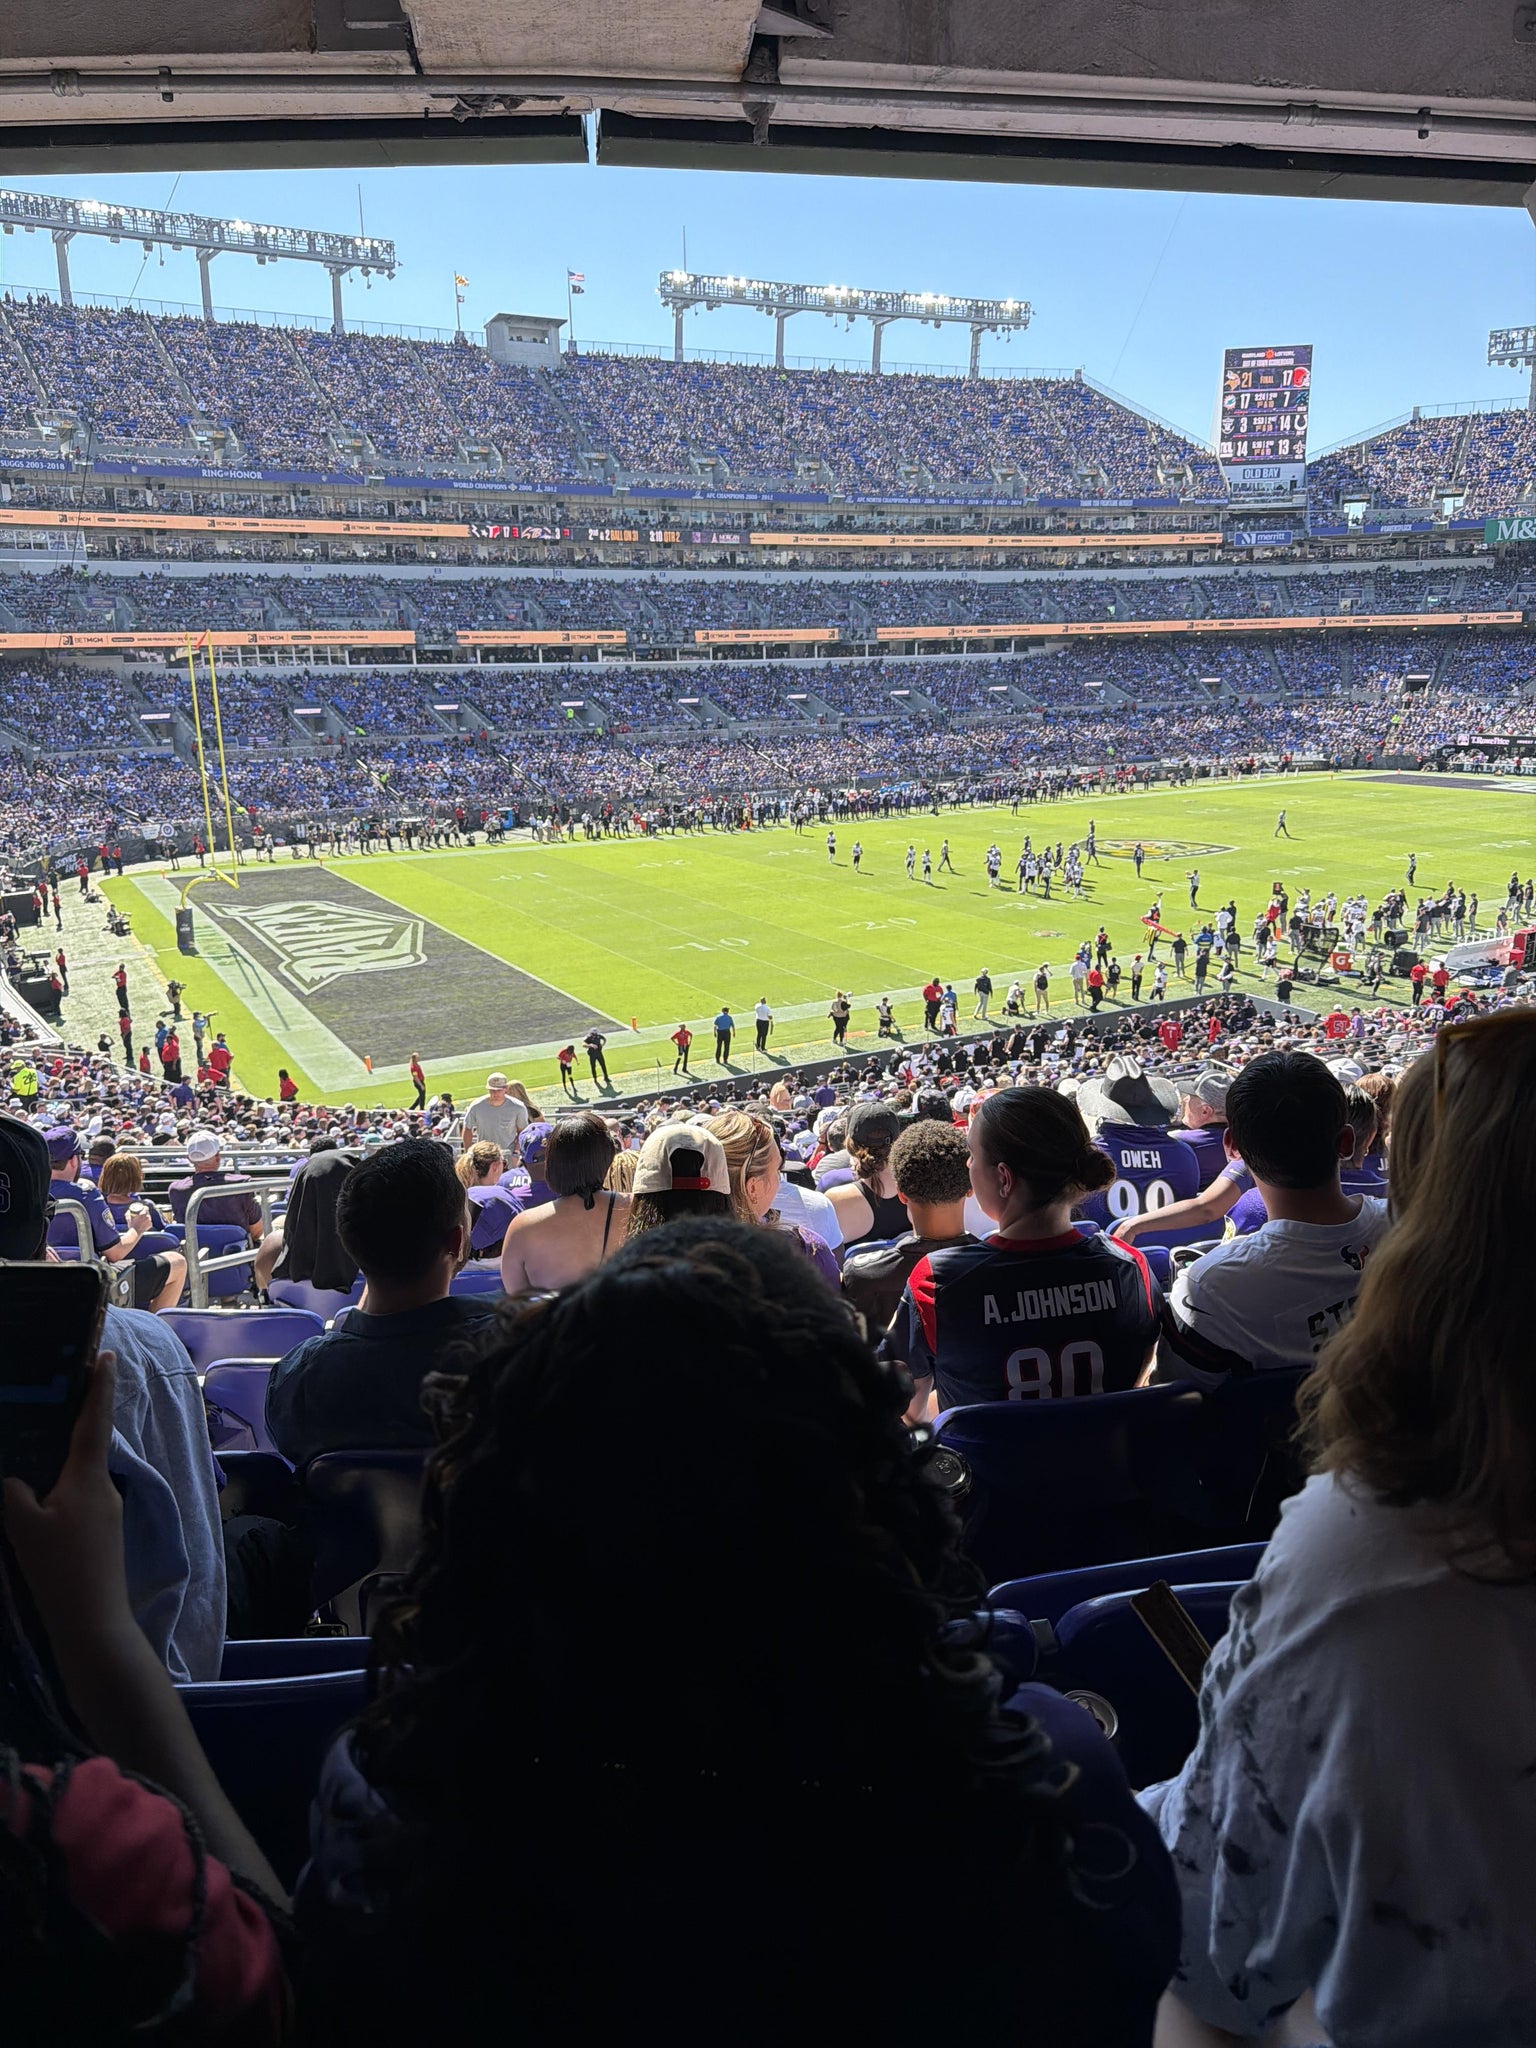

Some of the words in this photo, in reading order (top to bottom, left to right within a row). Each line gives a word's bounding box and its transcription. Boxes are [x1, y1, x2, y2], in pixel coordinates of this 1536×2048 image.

[1241, 372, 1252, 388] 21
[1260, 375, 1274, 384] FINAL
[1283, 370, 1293, 386] 17
[1240, 393, 1250, 409] 17
[1284, 391, 1290, 407] 7
[1240, 417, 1247, 433] 3
[1280, 415, 1290, 431] 14
[1237, 440, 1248, 456] 14
[1278, 439, 1290, 455] 13
[0, 460, 24, 468] SUGGS
[24, 461, 65, 470] 2003-2018
[202, 469, 224, 477] RING
[229, 470, 263, 480] HONOR
[1244, 469, 1262, 479] OLD
[1262, 468, 1280, 478] BAY
[474, 482, 507, 490] CHAMPIONS
[716, 491, 745, 499] CHAMPIONS
[610, 530, 623, 541] BALL
[1257, 533, 1285, 541] merritt
[1496, 518, 1536, 541] M&
[1462, 764, 1536, 775] BALTMOR
[217, 902, 416, 986] RAVENS
[1336, 956, 1346, 966] G
[1430, 1008, 1446, 1021] 88
[1120, 1150, 1162, 1169] OWEH
[983, 1280, 1117, 1325] A.JOHNSON
[1006, 1340, 1105, 1401] 80
